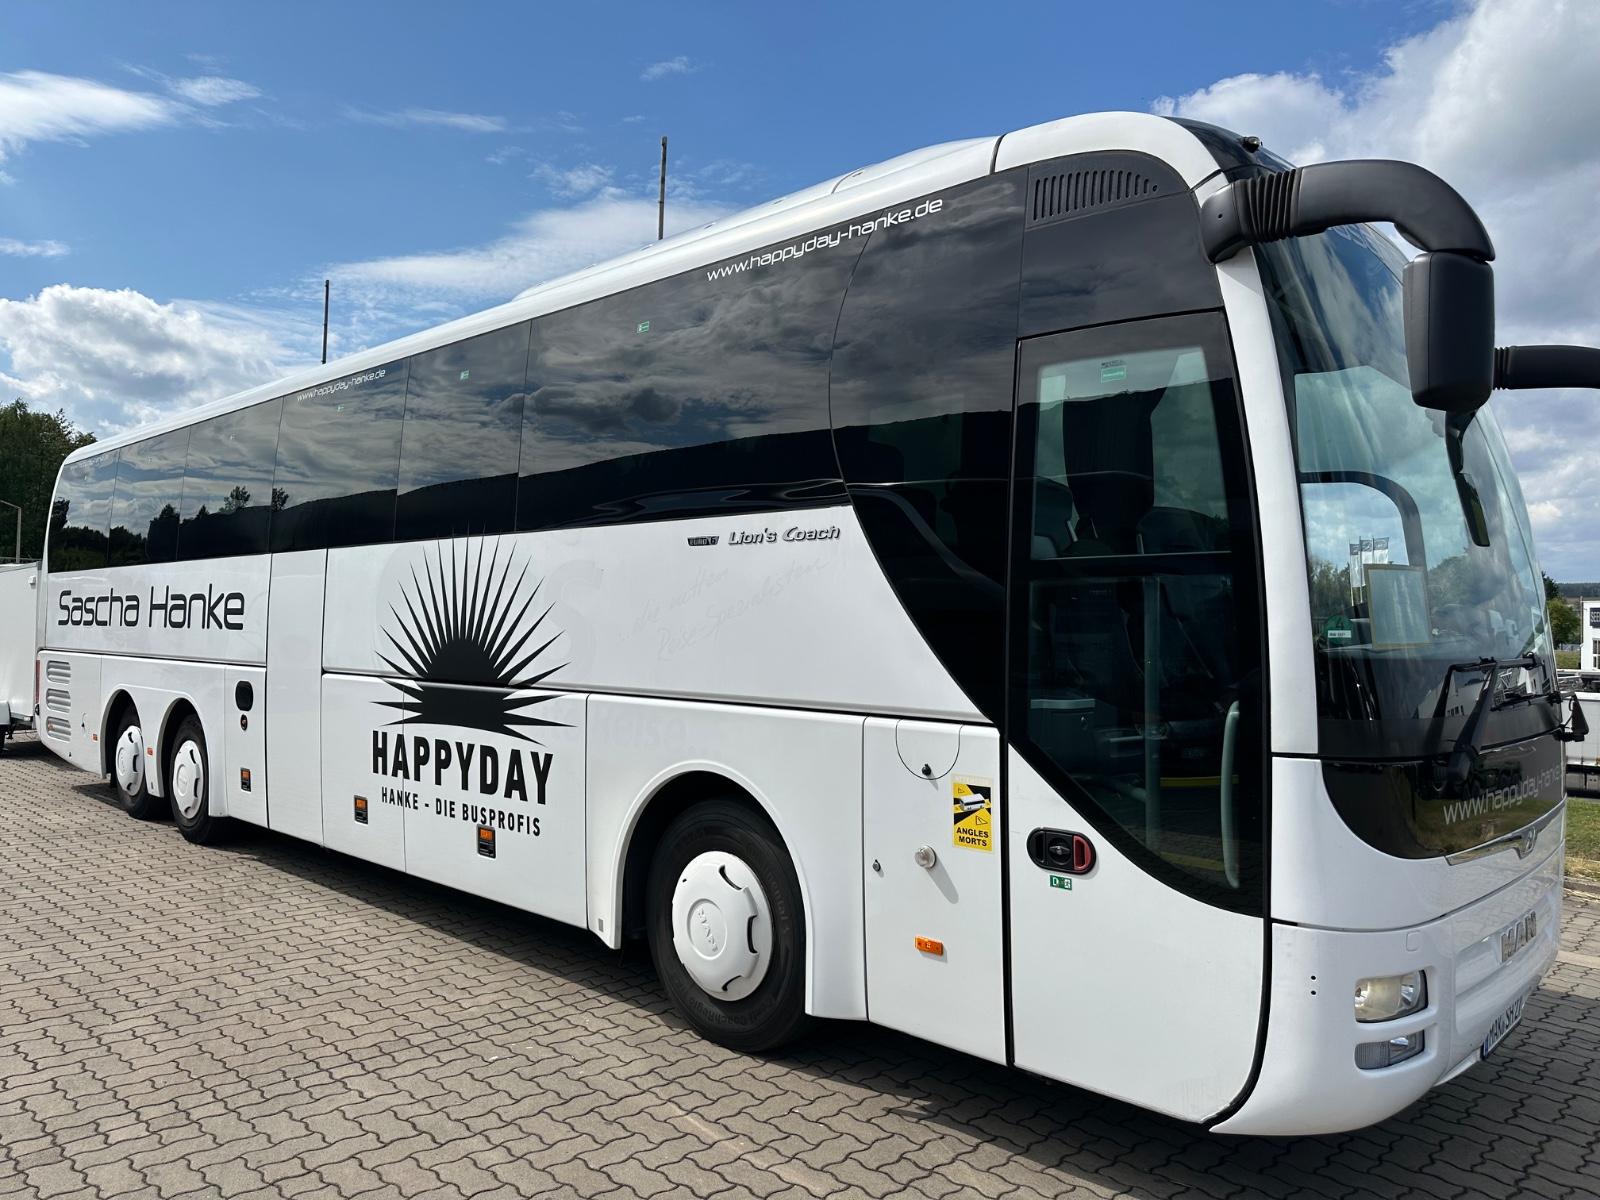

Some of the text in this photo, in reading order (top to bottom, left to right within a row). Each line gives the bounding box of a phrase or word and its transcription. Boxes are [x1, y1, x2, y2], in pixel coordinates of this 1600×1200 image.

[707, 199, 943, 281] www.happyday-hanke.de
[728, 526, 840, 545] Lion's Coach
[58, 583, 245, 630] Sascha Hanke
[372, 730, 554, 805] HAPPYDAY
[382, 787, 419, 810] HANKE
[436, 798, 456, 818] DIE
[462, 804, 541, 836] BUSPROFIS
[956, 827, 989, 839] ANGLES
[958, 836, 987, 847] MORTS
